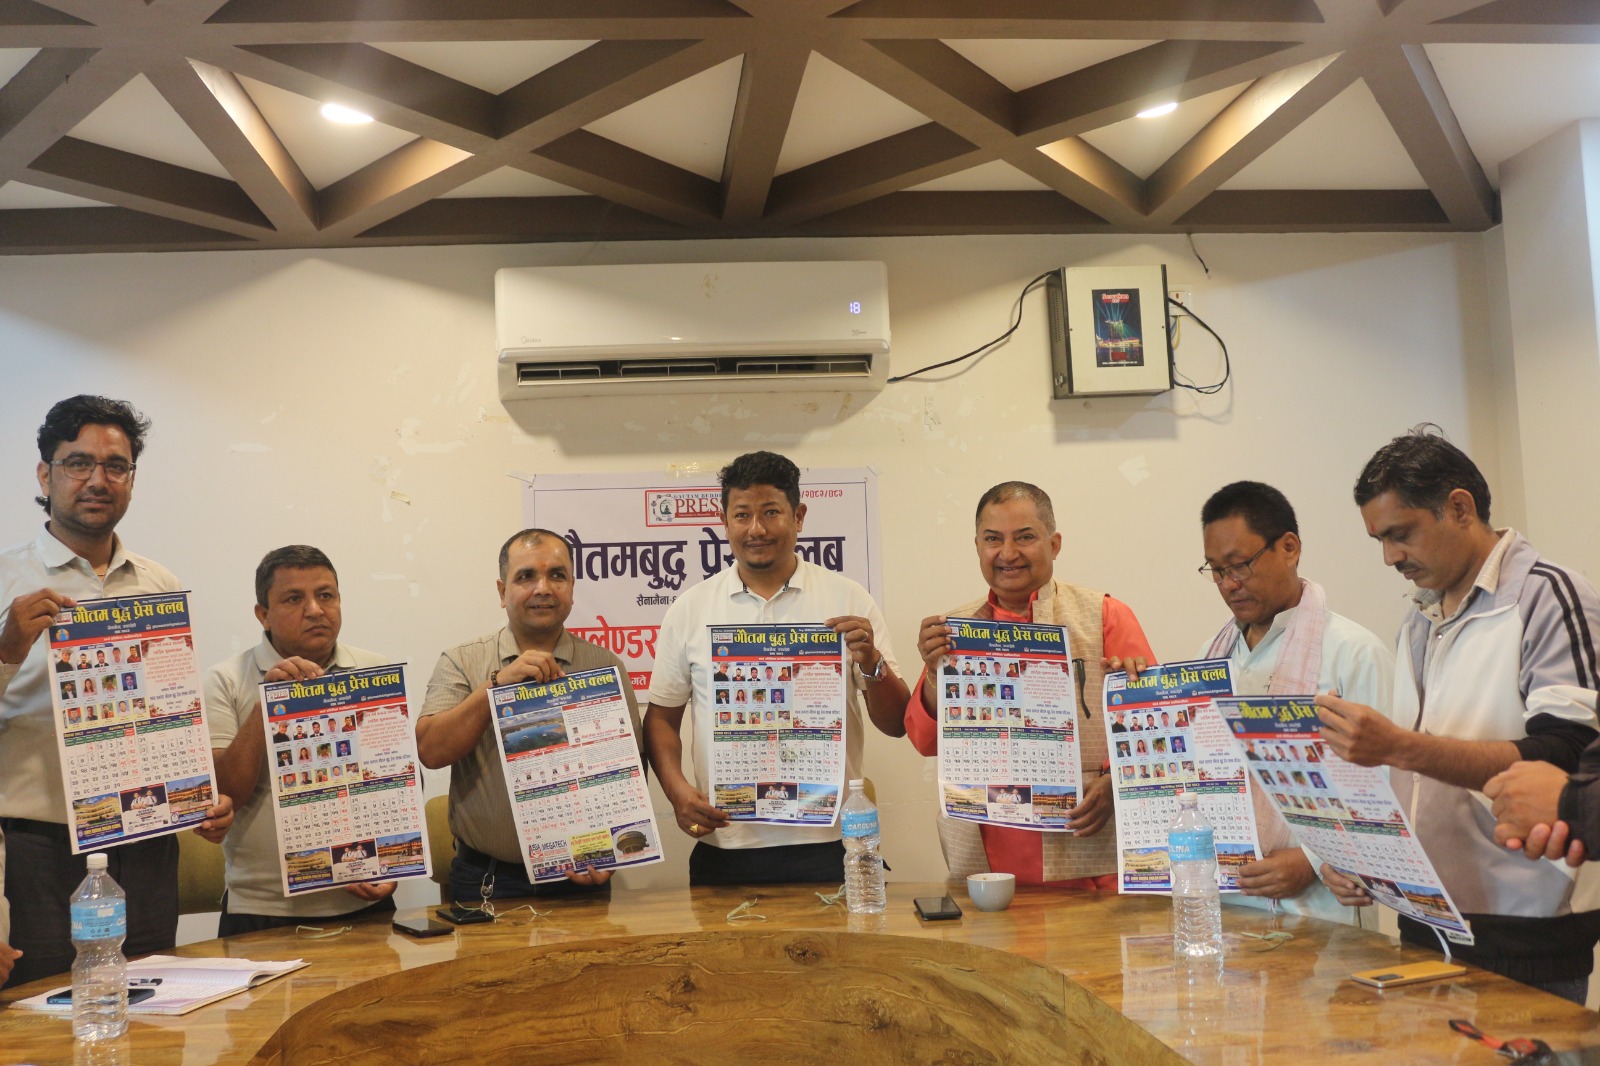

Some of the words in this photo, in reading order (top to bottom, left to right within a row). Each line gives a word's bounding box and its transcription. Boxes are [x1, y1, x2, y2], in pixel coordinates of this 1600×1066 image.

[850, 302, 860, 314] 18
[675, 498, 723, 513] PRES
[565, 529, 688, 590] ौतमबुद्ध
[794, 536, 846, 572] लब
[134, 600, 154, 619] प्रेस
[156, 600, 184, 615] क्लब
[566, 615, 661, 658] ालेण्डर
[790, 629, 808, 645] प्रेस
[810, 632, 838, 643] क्लब
[1013, 626, 1031, 642] प्रेस
[1034, 630, 1061, 642] क्लब
[350, 674, 369, 692] प्रेस
[372, 673, 400, 687] क्लब
[568, 676, 586, 692] प्रेस
[590, 673, 614, 686] क्लब
[632, 674, 647, 686] गते
[1180, 667, 1200, 685] प्रेस
[1201, 668, 1228, 681] क्लब
